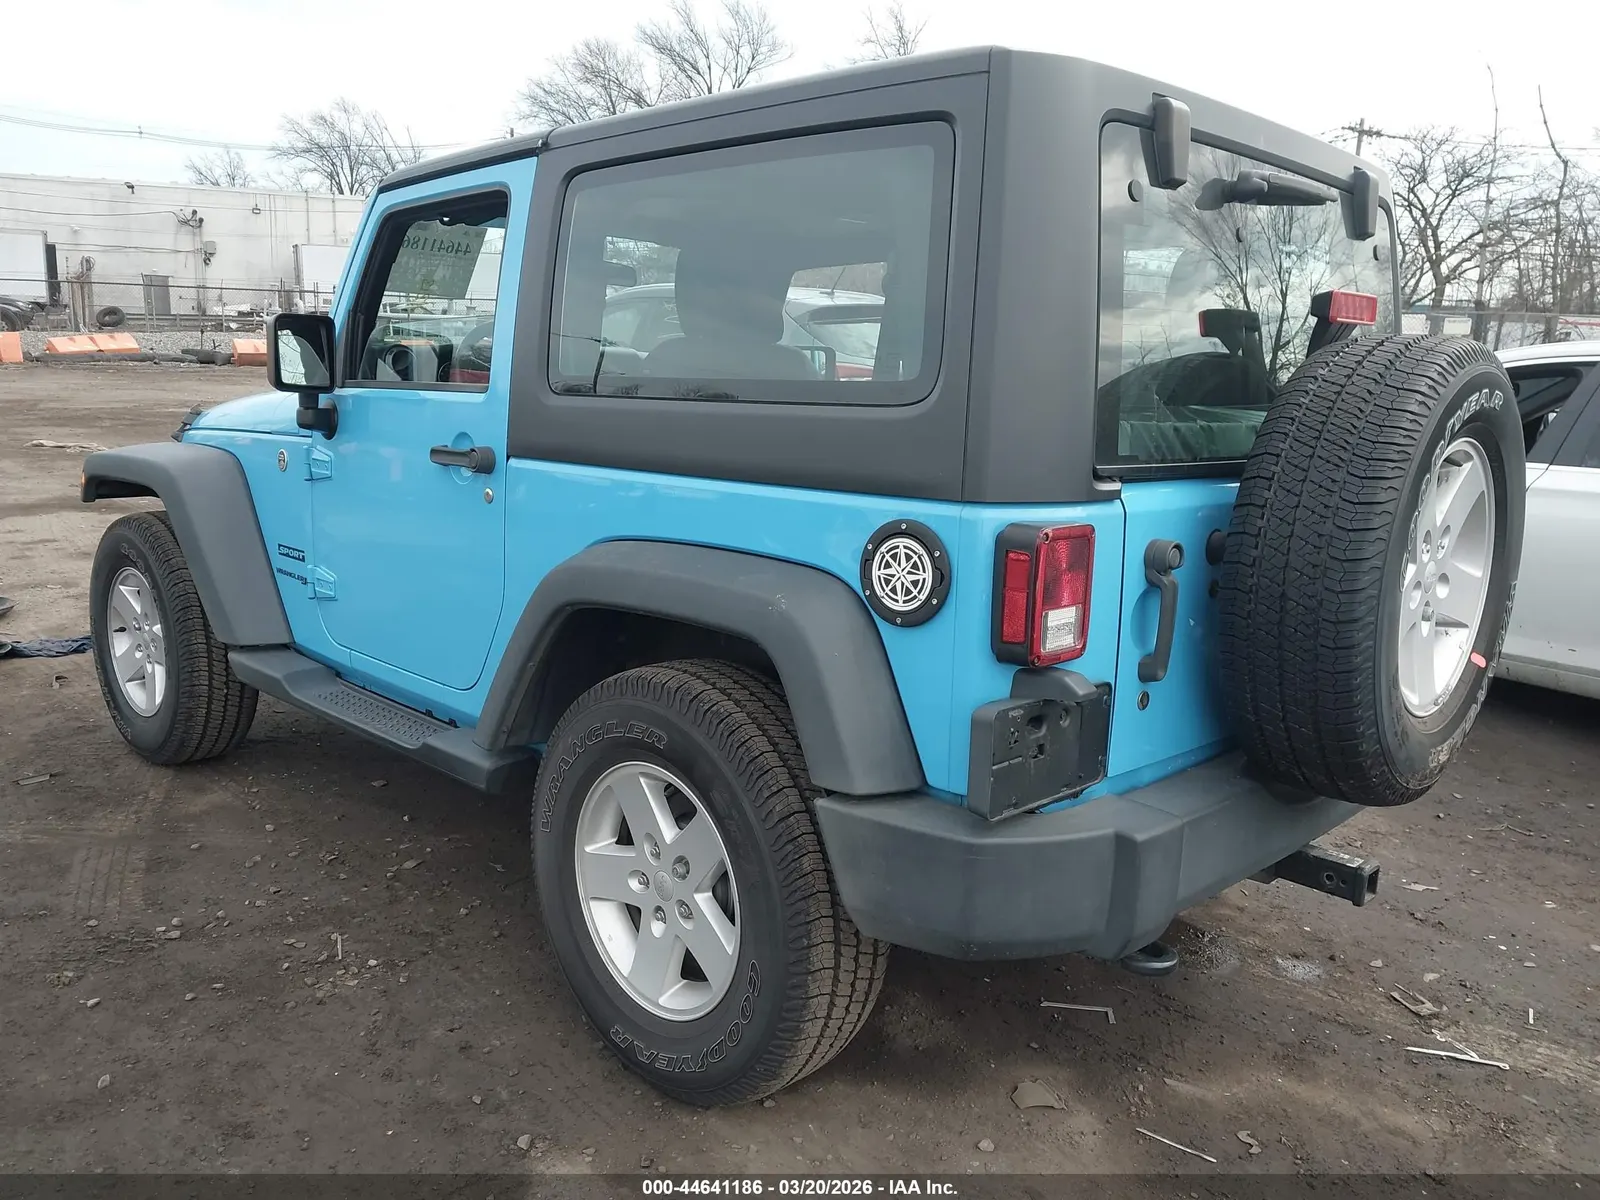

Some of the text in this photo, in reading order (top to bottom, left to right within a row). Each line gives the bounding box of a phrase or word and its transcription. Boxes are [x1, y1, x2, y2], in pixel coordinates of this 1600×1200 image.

[275, 566, 305, 583] WRANGLER
[278, 545, 305, 560] SPORT
[540, 720, 668, 833] WRANGLER
[609, 959, 761, 1072] GOODYEAR
